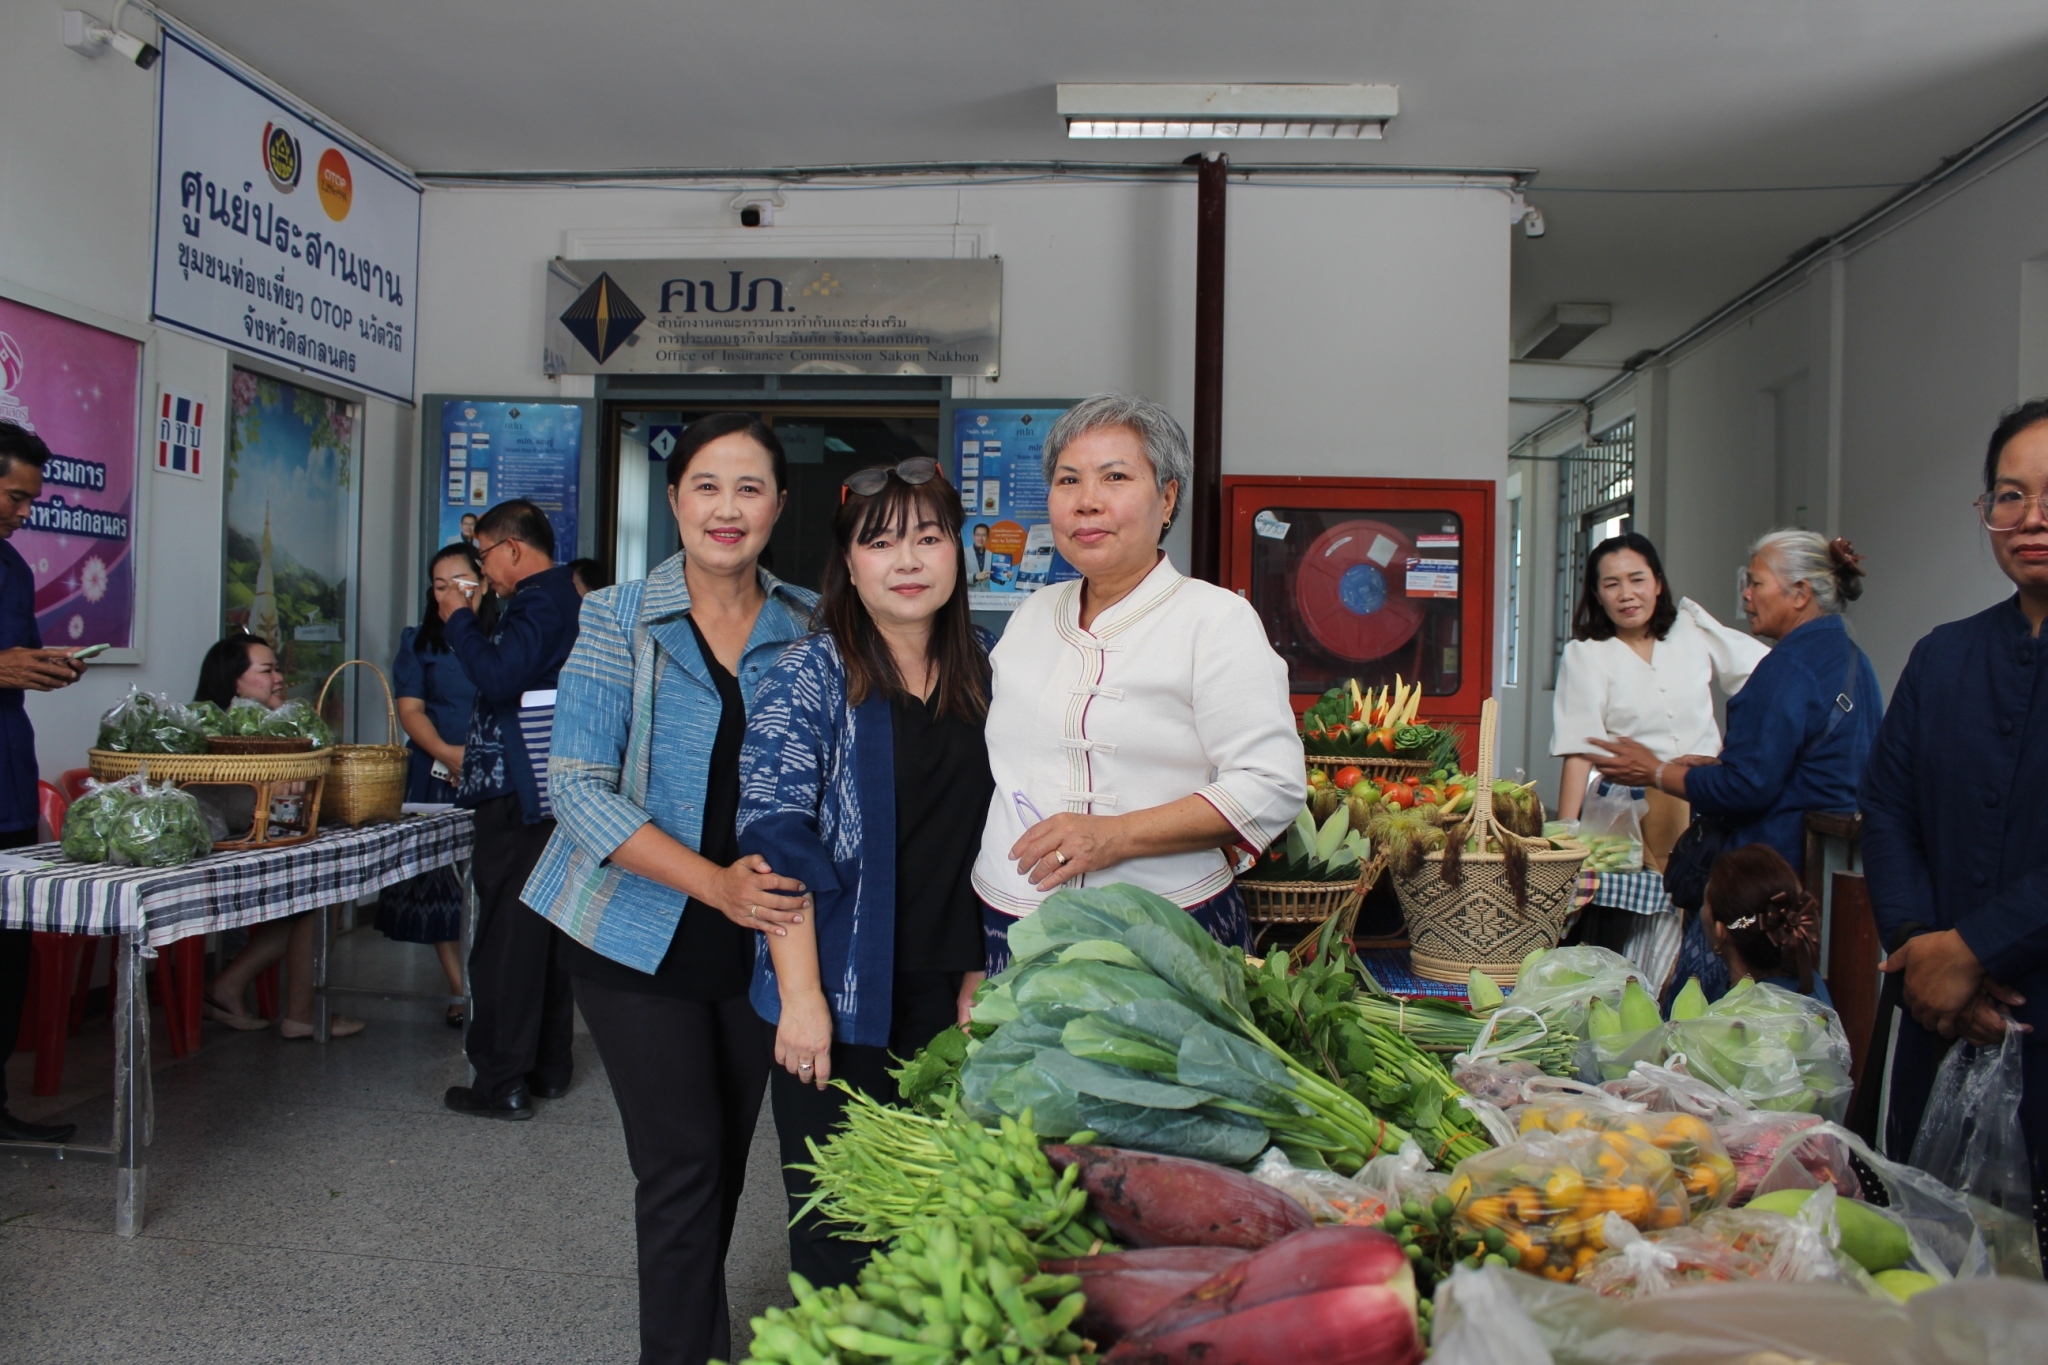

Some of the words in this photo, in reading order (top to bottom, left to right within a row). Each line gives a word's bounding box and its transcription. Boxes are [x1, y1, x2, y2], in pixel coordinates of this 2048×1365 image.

[324, 168, 347, 188] OTOP
[180, 170, 404, 308] ศูนย์ประสานงาน
[178, 242, 305, 314] ชุมชนท่องเที่ยว
[311, 296, 353, 332] OTOP
[359, 313, 402, 353] นวัตวิถี
[658, 270, 796, 313] คปภ.
[657, 315, 907, 328] สำนักงานคณะกรรมการกำกับและส่งเสริม
[243, 304, 356, 373] จังหวัดสกลนคร
[658, 330, 827, 346] การประกอบธุรกิจประกันภัย
[834, 331, 930, 344] จังหวัดสกลนคร
[656, 349, 696, 361] Office
[702, 349, 715, 361] of
[722, 350, 784, 361] Insurance
[790, 350, 872, 362] Commission
[879, 350, 920, 362] Sakon
[927, 350, 980, 362] Nakhon
[660, 436, 668, 451] 1
[43, 459, 104, 487] รรมการ
[27, 500, 127, 537] งหวัดสกลนคร
